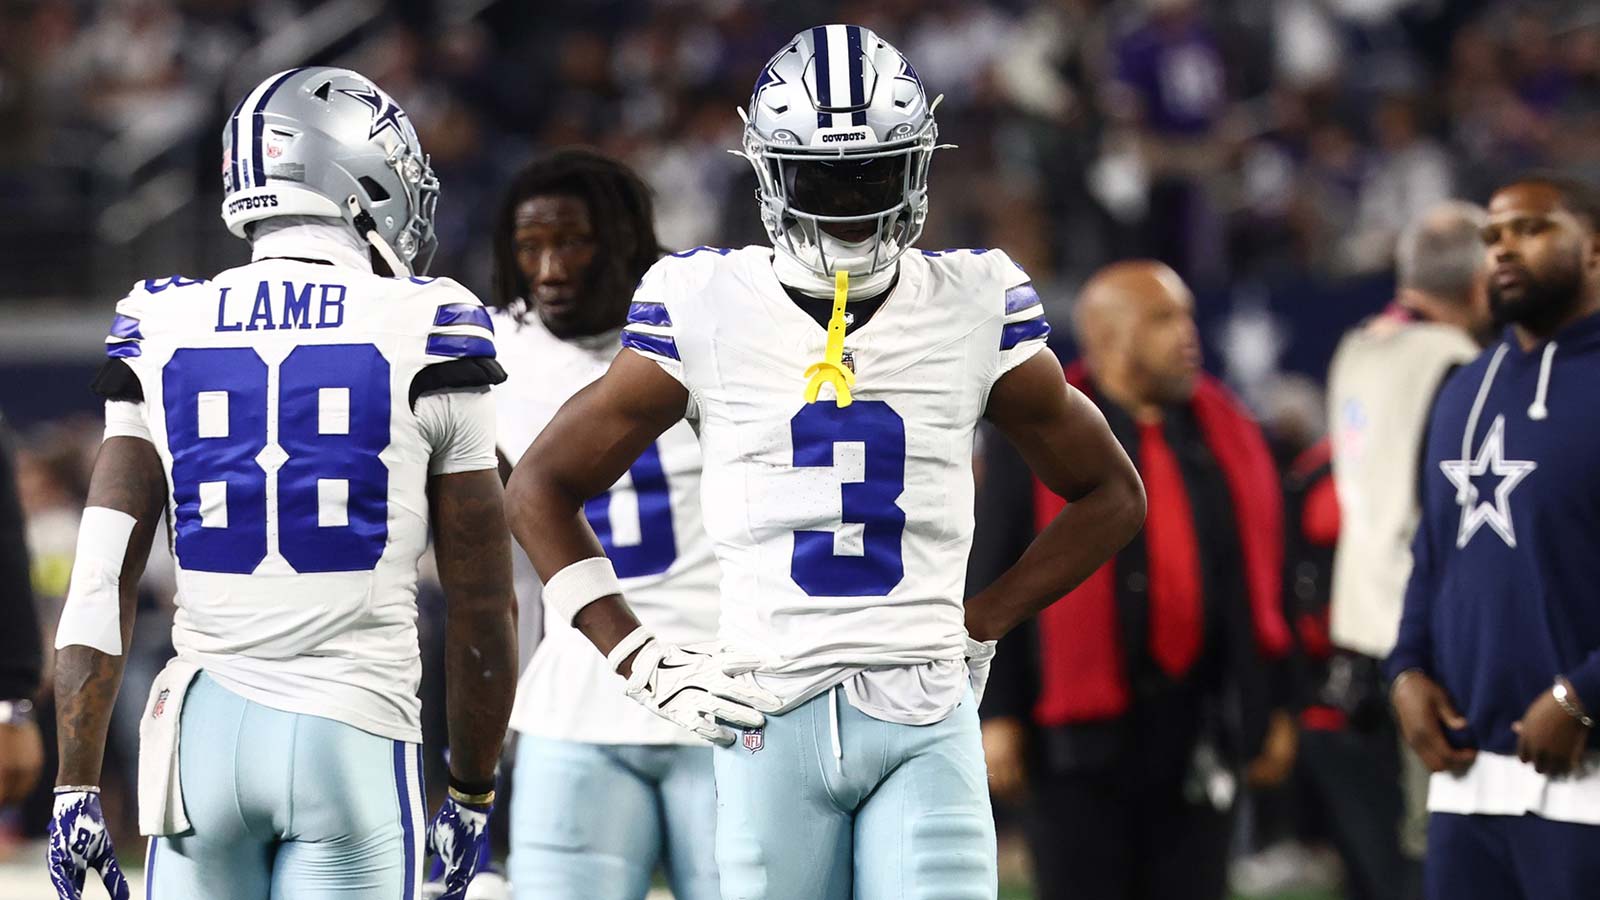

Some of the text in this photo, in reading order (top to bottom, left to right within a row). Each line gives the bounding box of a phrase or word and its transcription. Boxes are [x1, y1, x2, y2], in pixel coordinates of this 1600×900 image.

[822, 131, 866, 142] COWBOYS
[214, 280, 347, 332] LAMB
[162, 343, 391, 575] 88
[791, 400, 906, 597] 3
